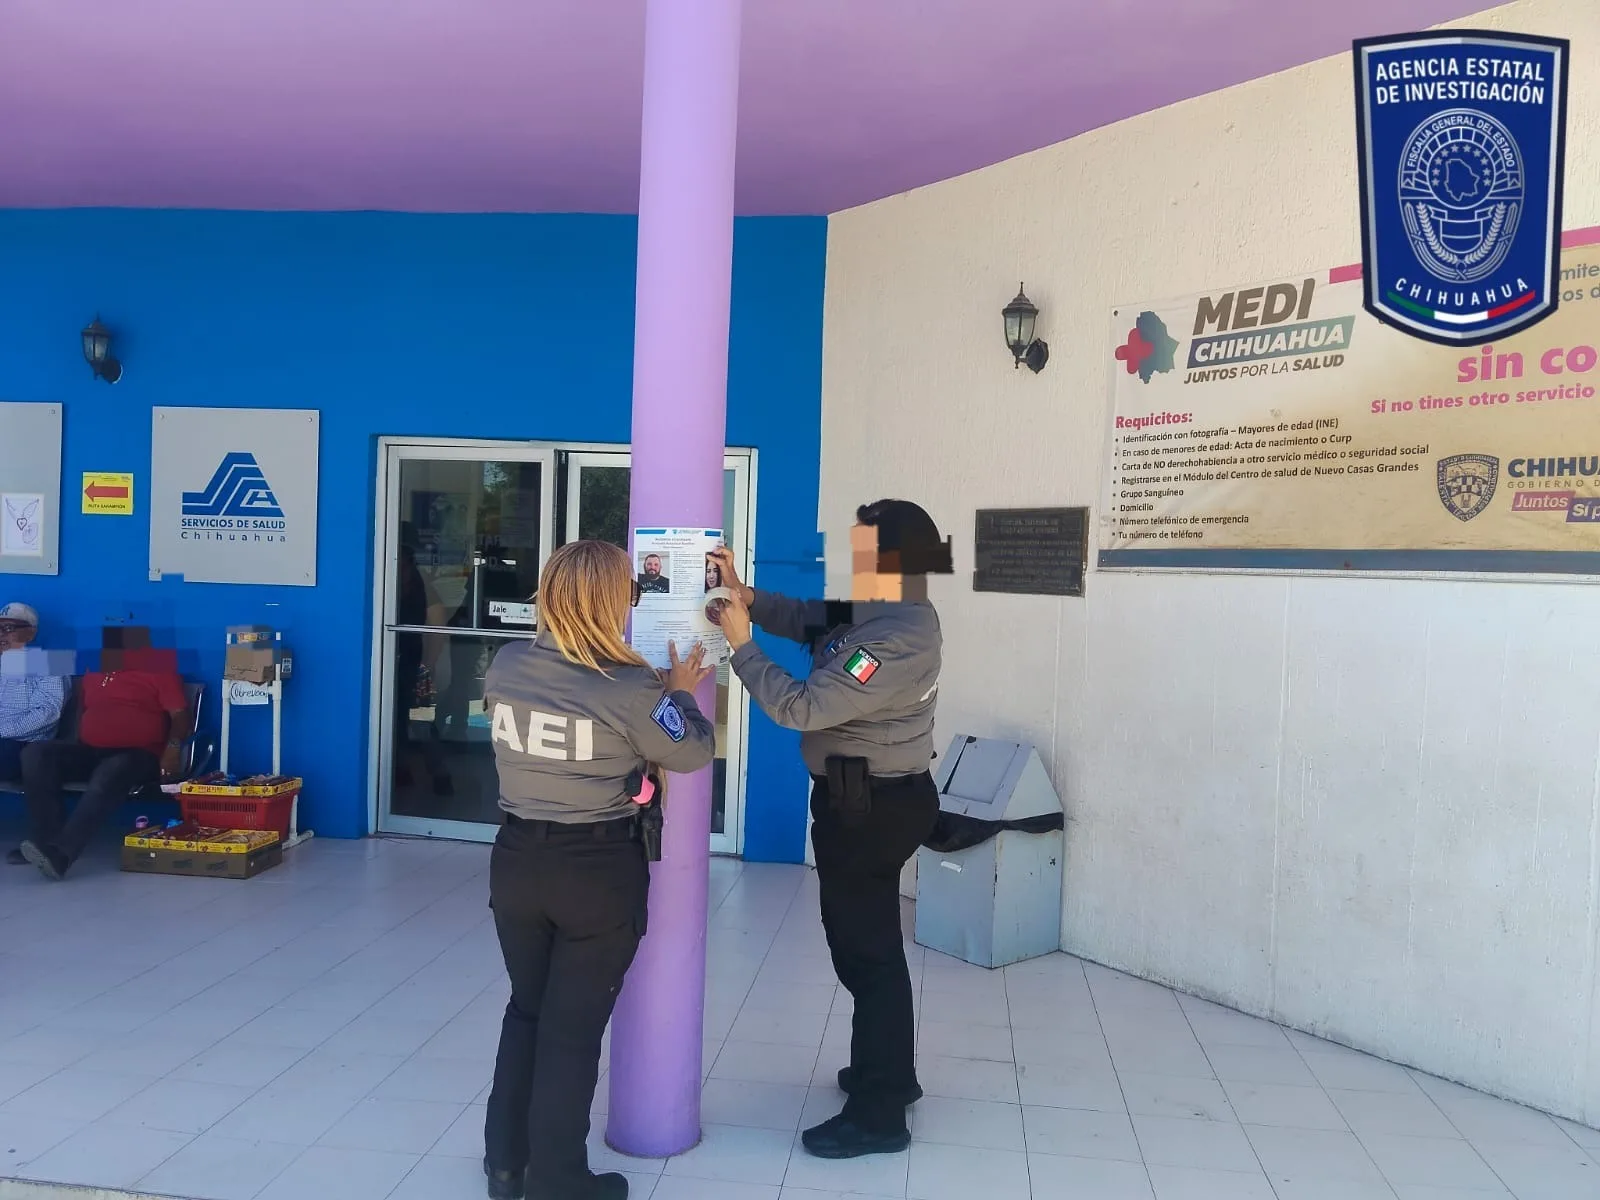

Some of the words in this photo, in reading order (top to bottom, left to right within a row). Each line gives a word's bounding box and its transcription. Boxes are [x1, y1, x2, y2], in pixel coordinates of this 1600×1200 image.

[1192, 277, 1316, 336] MEDI
[1558, 289, 1584, 302] os
[1194, 323, 1345, 363] CHIHUAHUA
[1183, 367, 1238, 385] JUNTOS
[1240, 363, 1268, 378] POR
[1271, 361, 1289, 375] LA
[1292, 354, 1345, 372] SALUD
[1456, 345, 1524, 384] sin
[1540, 345, 1598, 375] co
[1371, 399, 1386, 414] Si
[1391, 400, 1414, 413] no
[1419, 395, 1464, 410] tines
[1468, 391, 1510, 407] otro
[1515, 383, 1595, 403] servicio
[1116, 411, 1193, 431] Requicitos:
[1123, 432, 1173, 443] Identificación
[1174, 432, 1188, 440] con
[1190, 427, 1229, 439] fotografía
[1238, 425, 1275, 436] Mayores
[1277, 422, 1289, 432] de
[1290, 420, 1314, 431] edad
[1315, 418, 1339, 430] (INE)
[1122, 449, 1132, 457] En
[1151, 447, 1161, 455] de
[1162, 446, 1196, 455] menores
[1197, 443, 1208, 452] de
[1209, 441, 1233, 451] edad:
[1234, 440, 1253, 449] Acta
[1255, 440, 1267, 448] de
[1268, 436, 1319, 447] nacimiento
[1329, 434, 1353, 444] Curp
[1121, 463, 1141, 471] Carta
[1142, 461, 1152, 470] de
[1153, 460, 1166, 469] NO
[1167, 456, 1238, 468] derechohabiencia
[1246, 456, 1265, 464] otro
[1267, 452, 1301, 463] servicio
[1303, 450, 1338, 461] médico
[1339, 451, 1346, 459] o
[1348, 446, 1398, 459] seguridad
[1400, 444, 1430, 455] social
[1507, 455, 1600, 478] CHIHU
[1121, 475, 1161, 486] Registrarse
[1174, 474, 1181, 482] el
[1182, 472, 1214, 482] Módulo
[1215, 470, 1229, 480] del
[1230, 470, 1259, 479] Centro
[1261, 468, 1271, 478] de
[1274, 467, 1298, 478] salud
[1300, 465, 1312, 476] de
[1314, 465, 1345, 475] Nuevo
[1347, 464, 1374, 474] Casas
[1376, 461, 1420, 474] Grandes
[1507, 479, 1584, 489] GOBIERNO
[1120, 490, 1143, 499] Grupo
[1144, 488, 1184, 499] Sanguíneo
[1515, 494, 1569, 508] Juntos
[1120, 503, 1154, 512] Domicilio
[181, 518, 234, 528] SERVICIOS
[236, 519, 249, 528] DE
[252, 519, 286, 529] SALUD
[1119, 516, 1149, 526] Número
[1150, 515, 1188, 525] telefónico
[1189, 515, 1200, 524] de
[1201, 514, 1249, 526] emergencia
[180, 531, 286, 542] Chihuahua
[1119, 531, 1128, 540] Tu
[1129, 530, 1158, 539] número
[1158, 530, 1169, 539] de
[1170, 529, 1203, 539] teléfono
[491, 702, 593, 761] AEI
